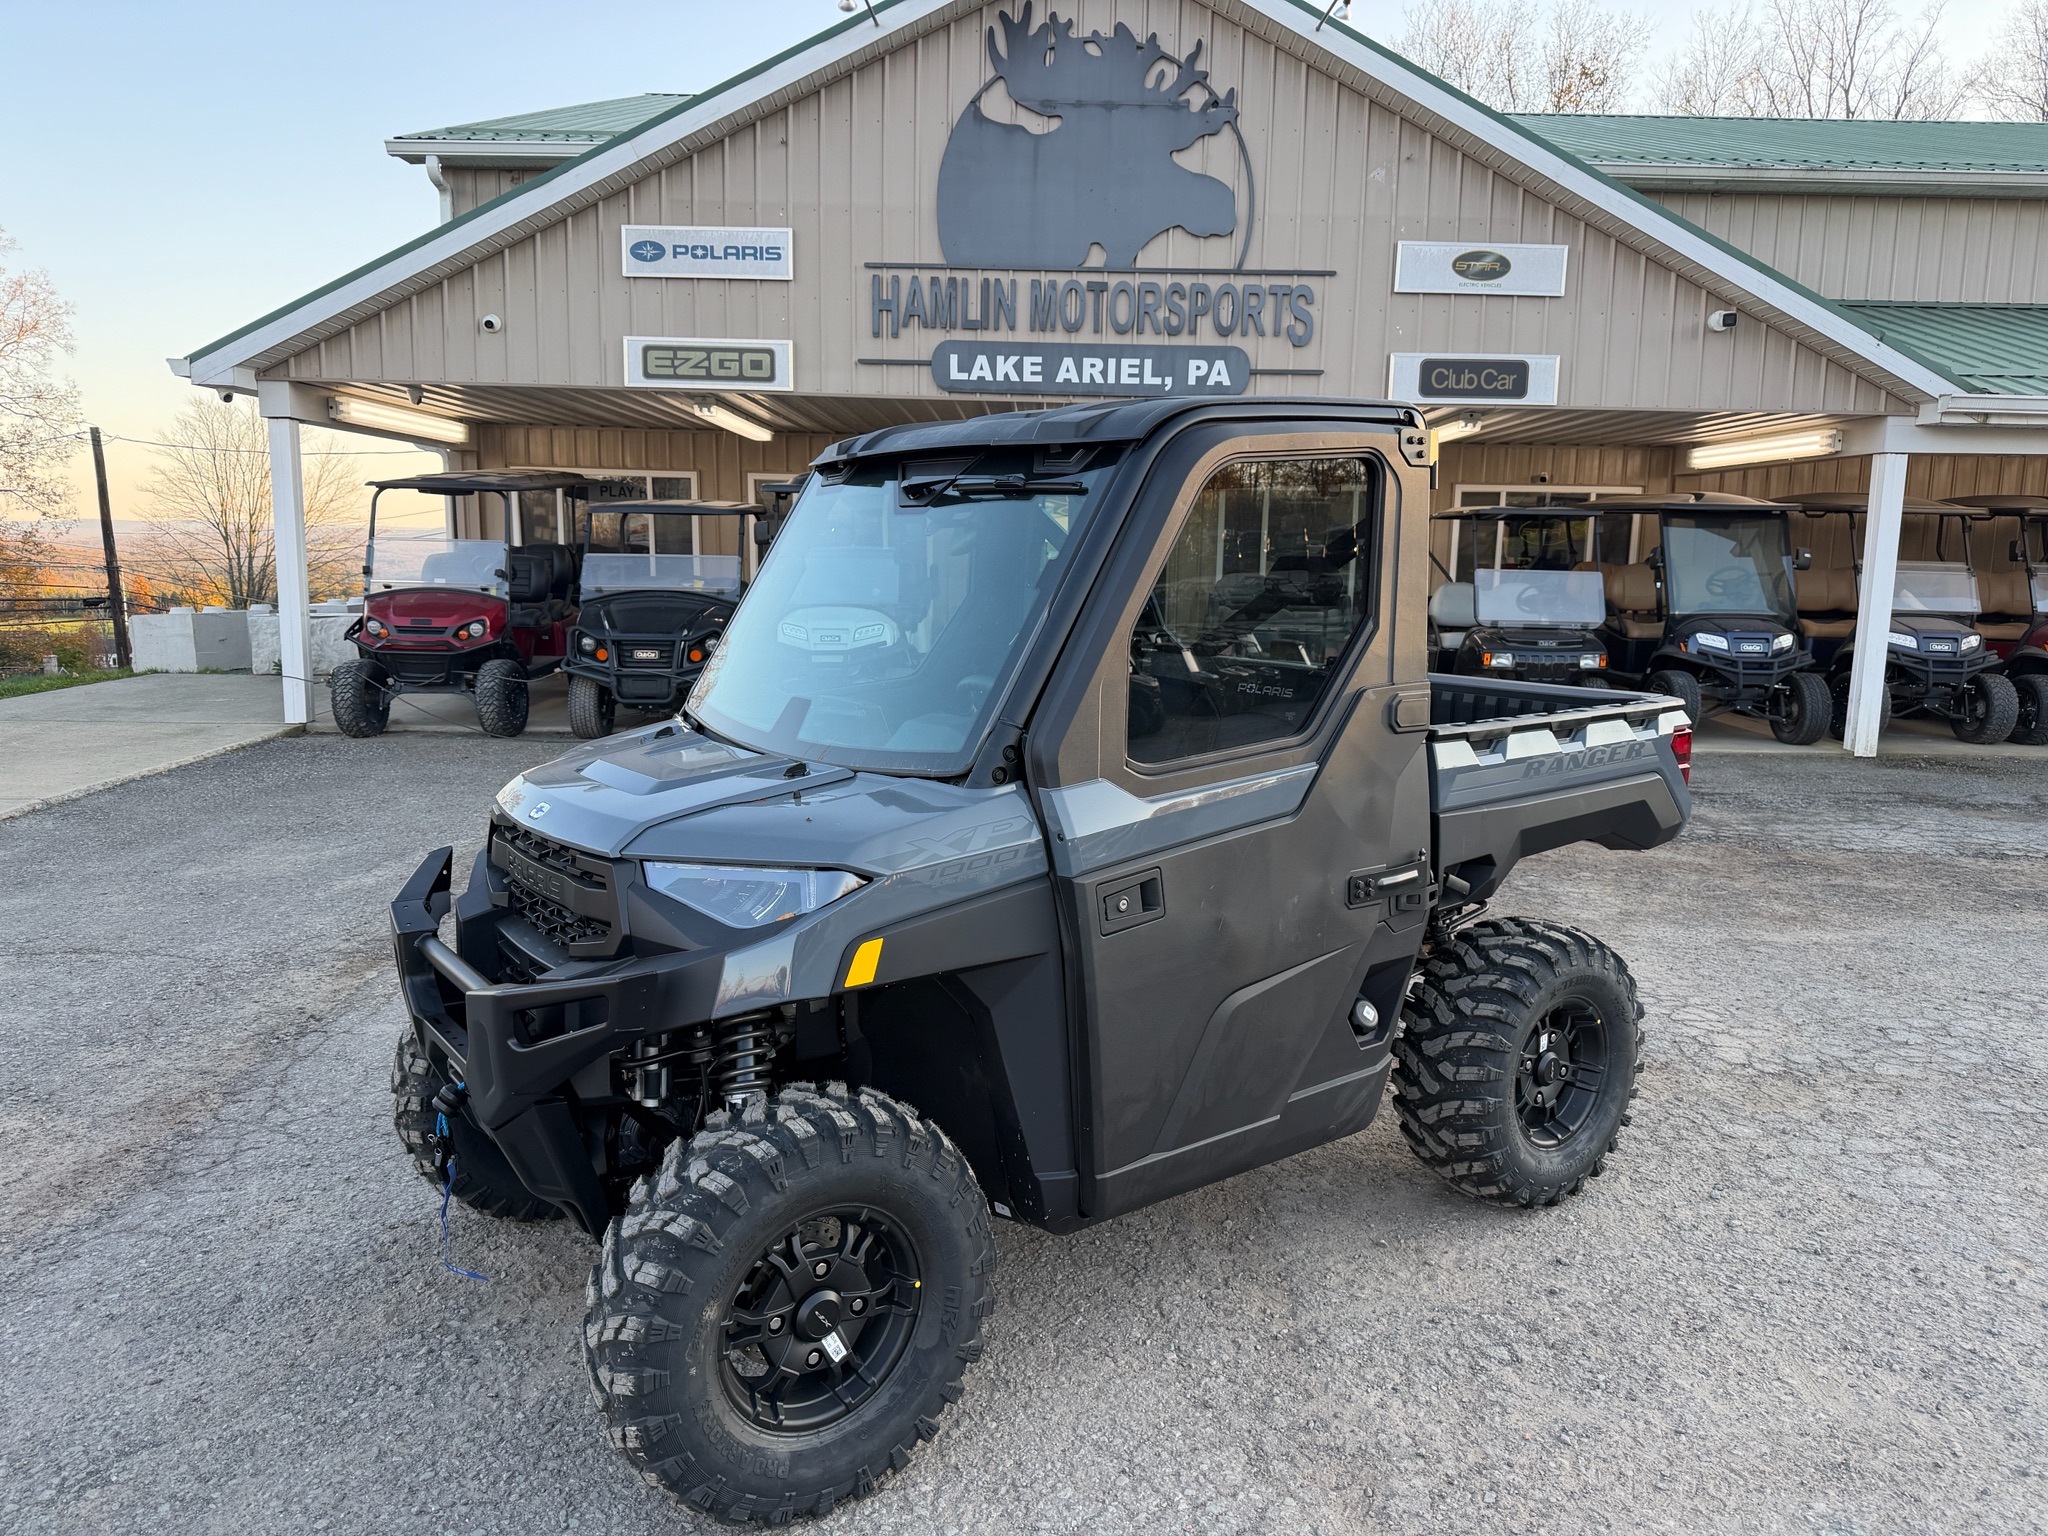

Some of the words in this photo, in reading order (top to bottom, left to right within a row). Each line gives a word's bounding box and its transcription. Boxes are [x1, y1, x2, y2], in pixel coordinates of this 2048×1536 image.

[672, 244, 782, 261] POLARIS
[1455, 262, 1500, 271] STAR
[871, 274, 1016, 338] HAMLIN
[1030, 278, 1314, 347] MOTORSPORTS
[647, 350, 772, 378] EZGO
[949, 354, 1043, 383] LAKE
[1055, 357, 1173, 391] ARIEL,
[1187, 359, 1231, 386] PA
[1431, 368, 1478, 389] Club
[1481, 368, 1517, 390] Car
[600, 485, 634, 498] PLAY
[1237, 683, 1294, 698] POLARIS
[1522, 741, 1646, 779] RANGER
[898, 815, 1032, 869] XP
[508, 850, 561, 900] POLARIS
[929, 848, 1020, 881] 1000
[752, 1456, 790, 1479] PRO
